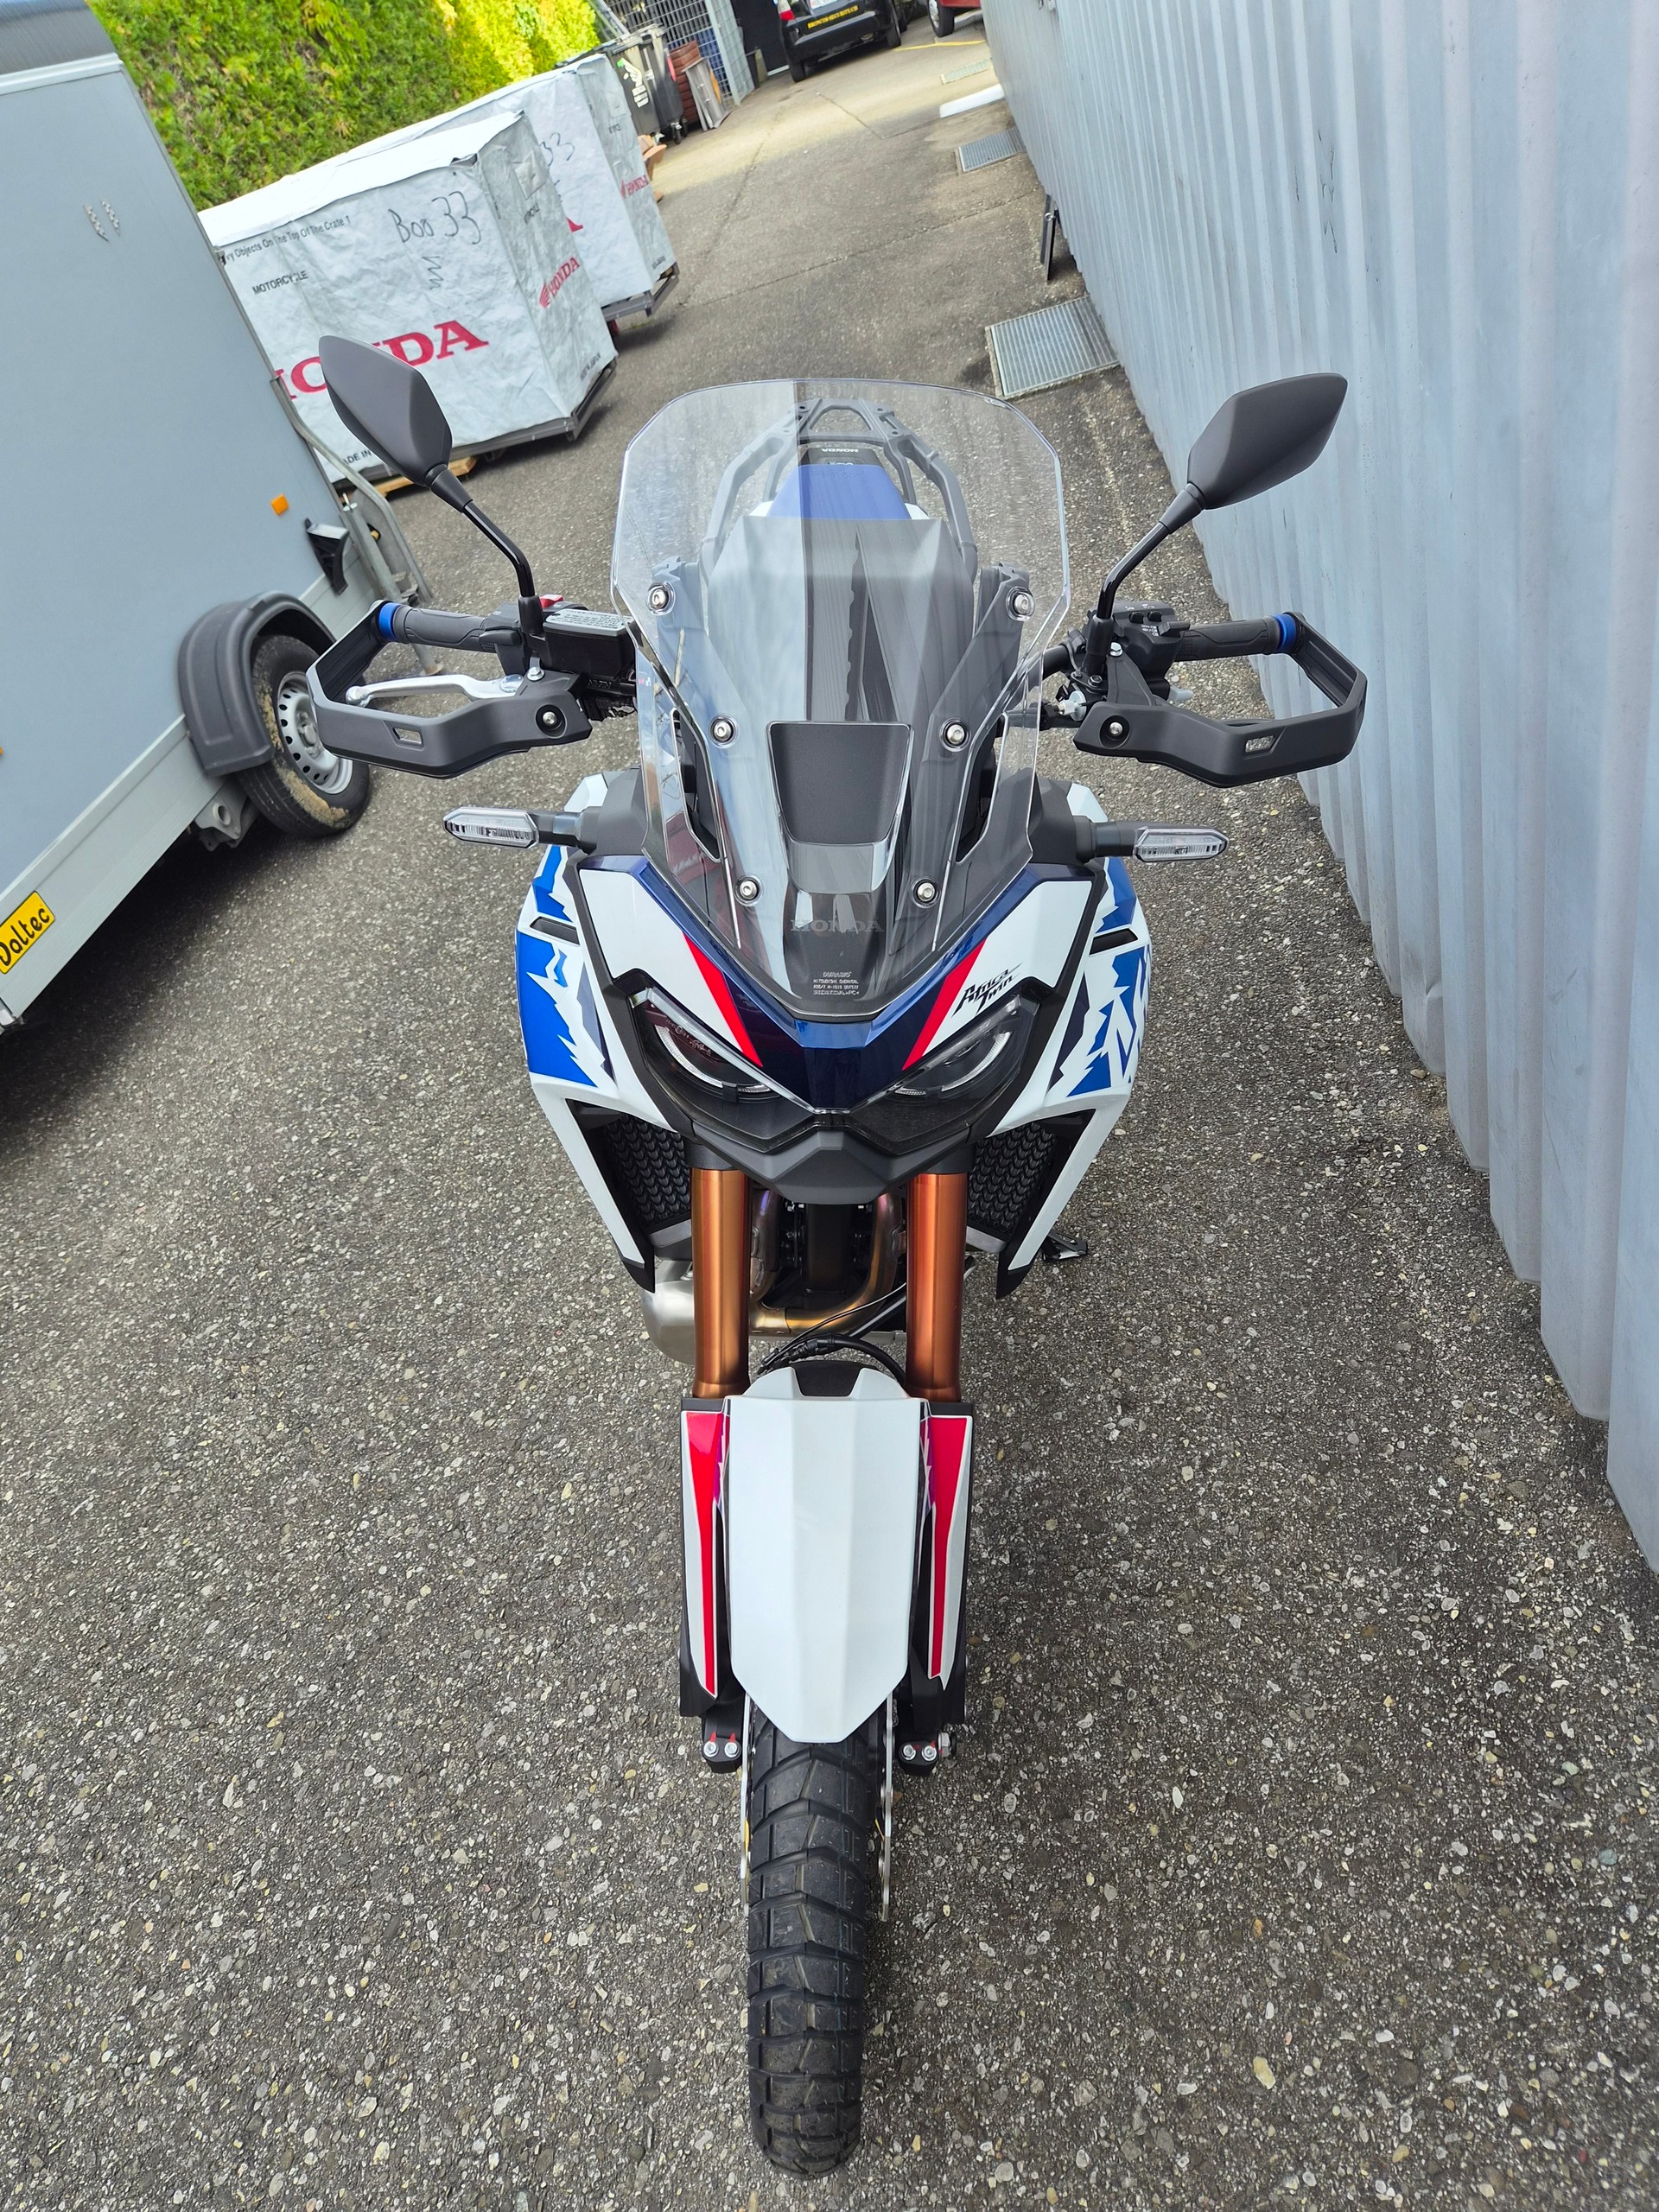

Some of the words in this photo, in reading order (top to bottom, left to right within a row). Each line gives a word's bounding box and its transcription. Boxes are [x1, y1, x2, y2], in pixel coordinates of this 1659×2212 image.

[234, 244, 262, 257] Objects
[262, 238, 275, 249] On
[287, 230, 301, 242] Top
[324, 218, 345, 232] Crate
[431, 191, 481, 245] 33
[251, 270, 309, 296] MOTORCYCLE
[275, 320, 489, 400] ODA
[0, 908, 49, 966] Daltec
[951, 967, 1013, 1018] Africa
[975, 975, 1014, 1016] Twin
